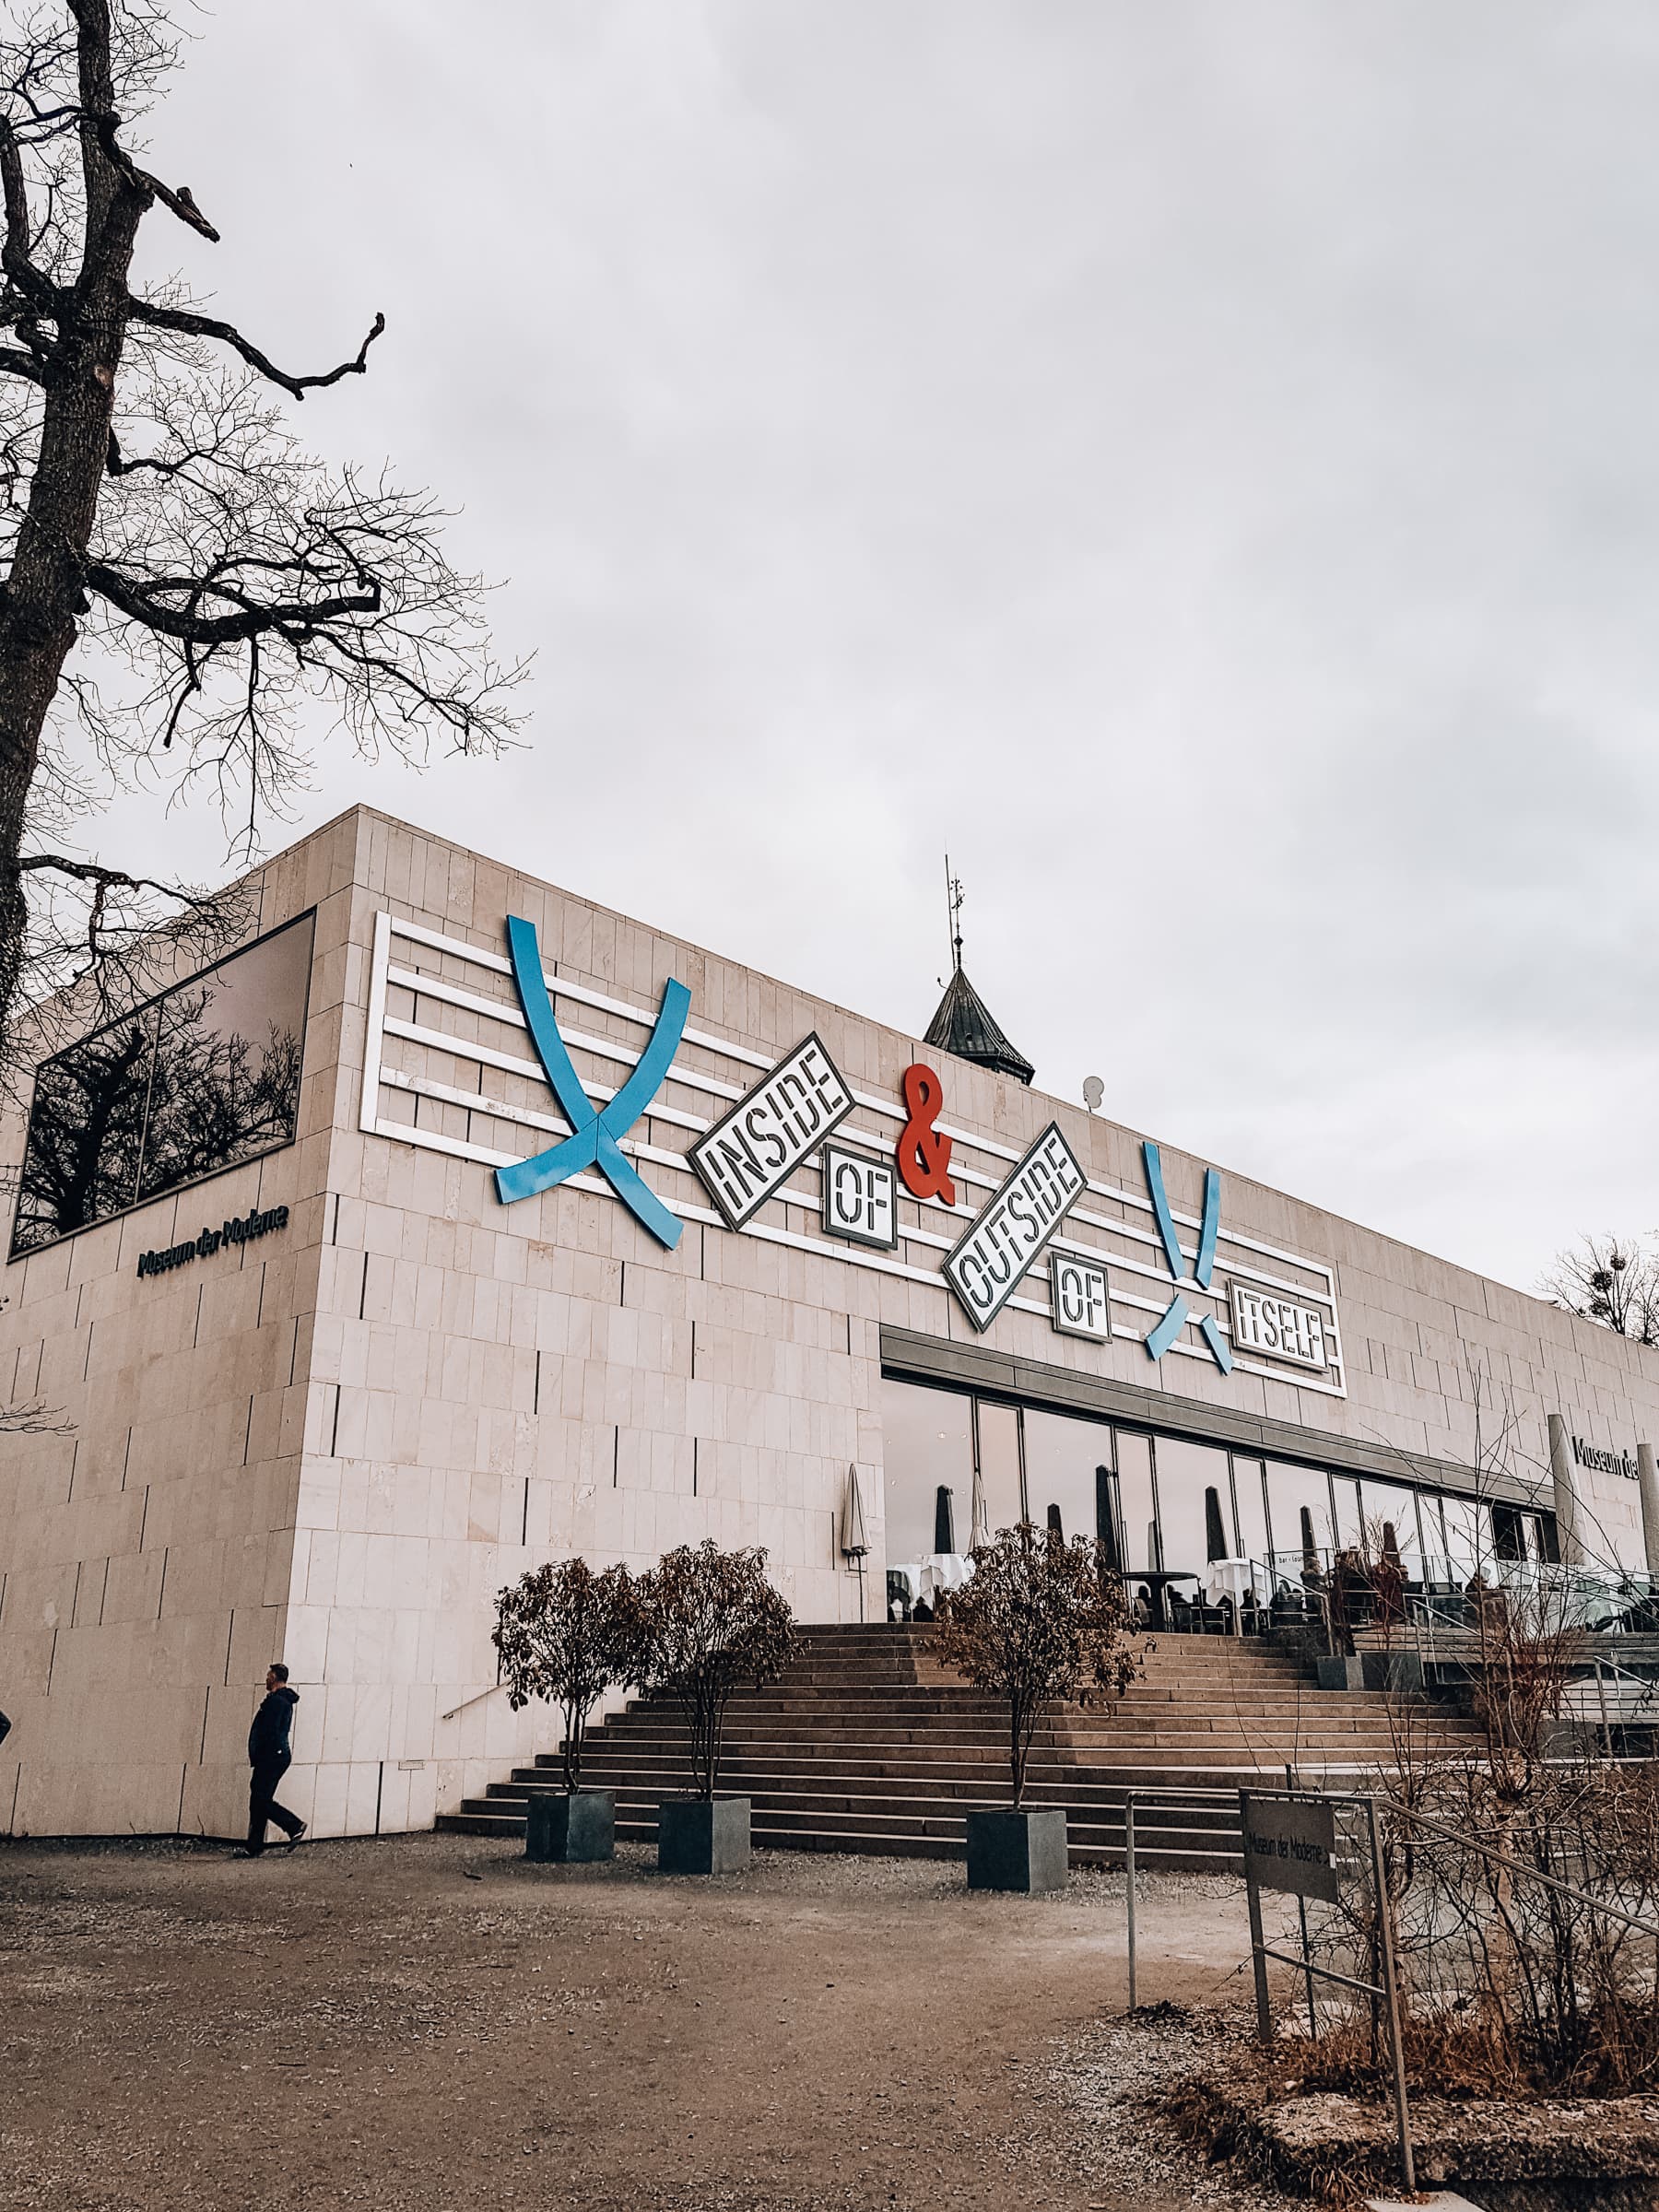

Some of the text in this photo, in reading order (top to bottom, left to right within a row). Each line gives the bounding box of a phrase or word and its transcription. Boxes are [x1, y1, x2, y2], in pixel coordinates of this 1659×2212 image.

[704, 1049, 843, 1210] INSIDE
[897, 1063, 956, 1206] &
[835, 1162, 888, 1230] OF
[959, 1137, 1079, 1309] OUTSIDE
[136, 1206, 289, 1278] Museum der Moderne
[1061, 1267, 1102, 1327] OF
[1238, 1290, 1320, 1359] ITSELF
[1571, 1435, 1640, 1480] Museum de
